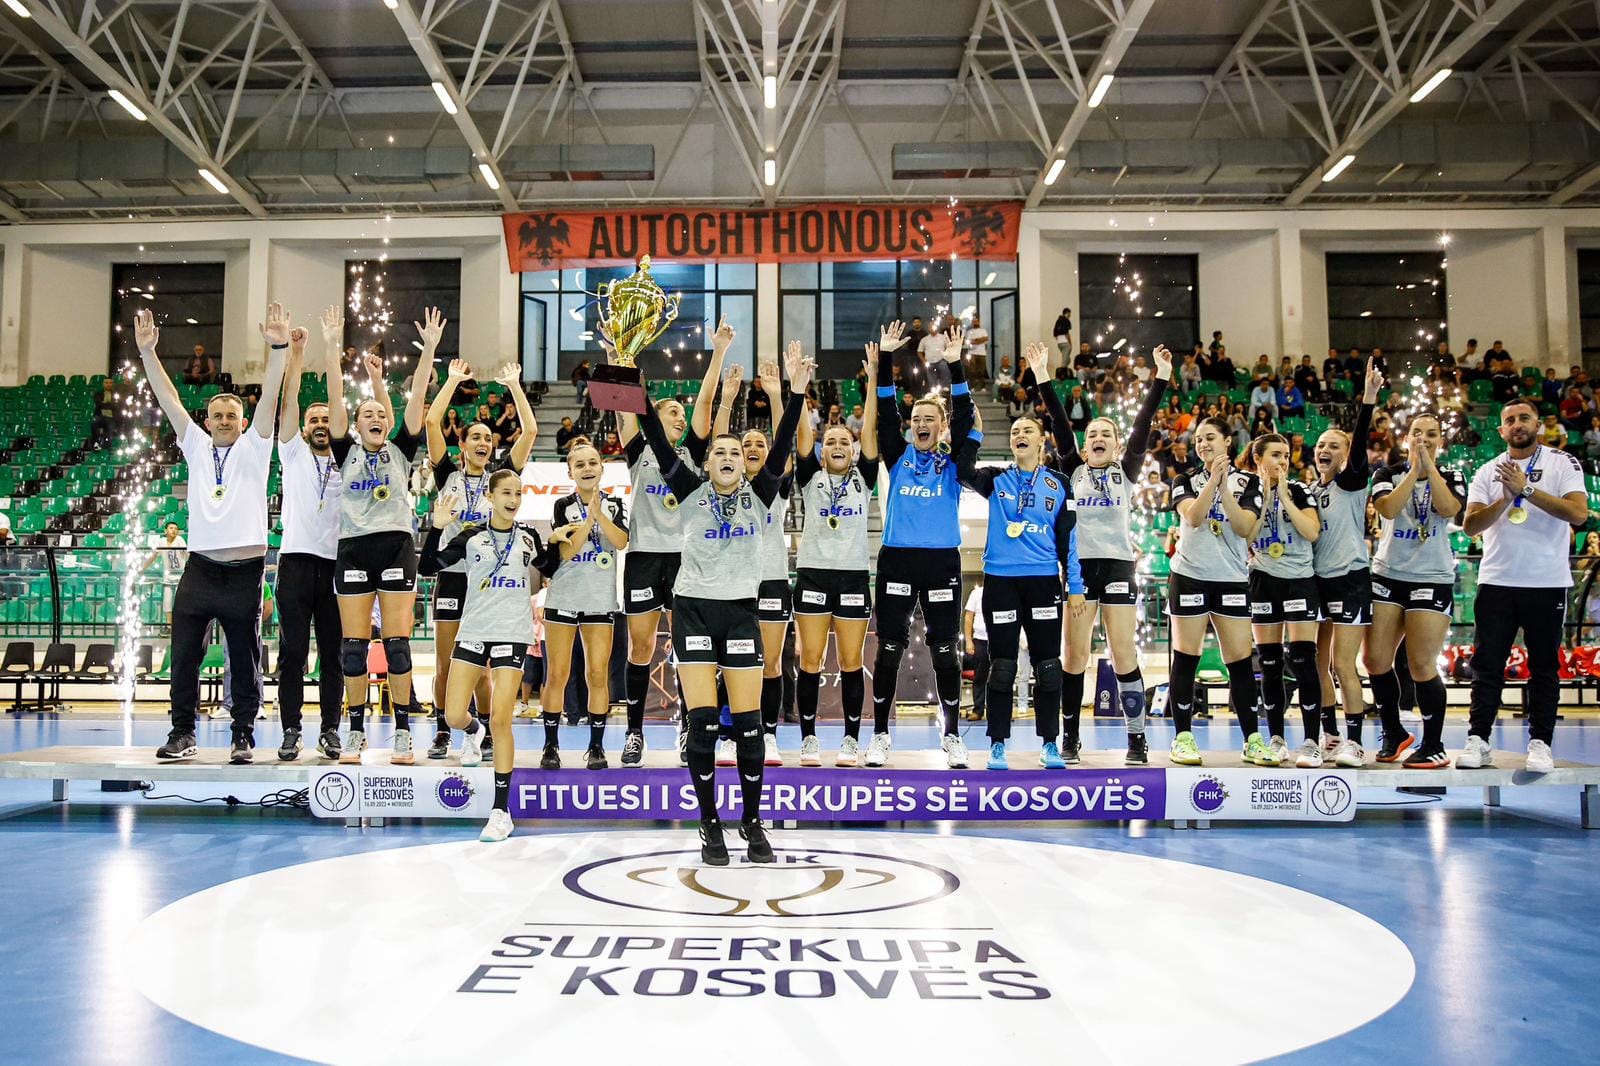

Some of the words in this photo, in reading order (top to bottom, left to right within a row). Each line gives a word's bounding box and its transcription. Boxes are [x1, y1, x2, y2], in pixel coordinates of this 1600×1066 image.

[588, 209, 934, 258] AUTOCHTHONOUS
[899, 484, 943, 498] alfa.i
[1076, 496, 1121, 507] alfai
[819, 503, 863, 517] afa.i
[363, 776, 414, 788] SUPERKUPA
[1251, 779, 1302, 790] SUPERKUPA
[364, 789, 370, 800] E
[444, 788, 464, 797] FHK
[519, 784, 650, 810] FITUESI
[661, 784, 668, 810] I
[925, 778, 969, 812] SË
[978, 777, 1146, 812] KOSOVËS
[1198, 791, 1218, 800] FHK
[1251, 792, 1257, 803] E
[491, 935, 1026, 963] SUPERKUPA
[456, 965, 534, 994] E
[560, 965, 1052, 1000] KOSOVËS
